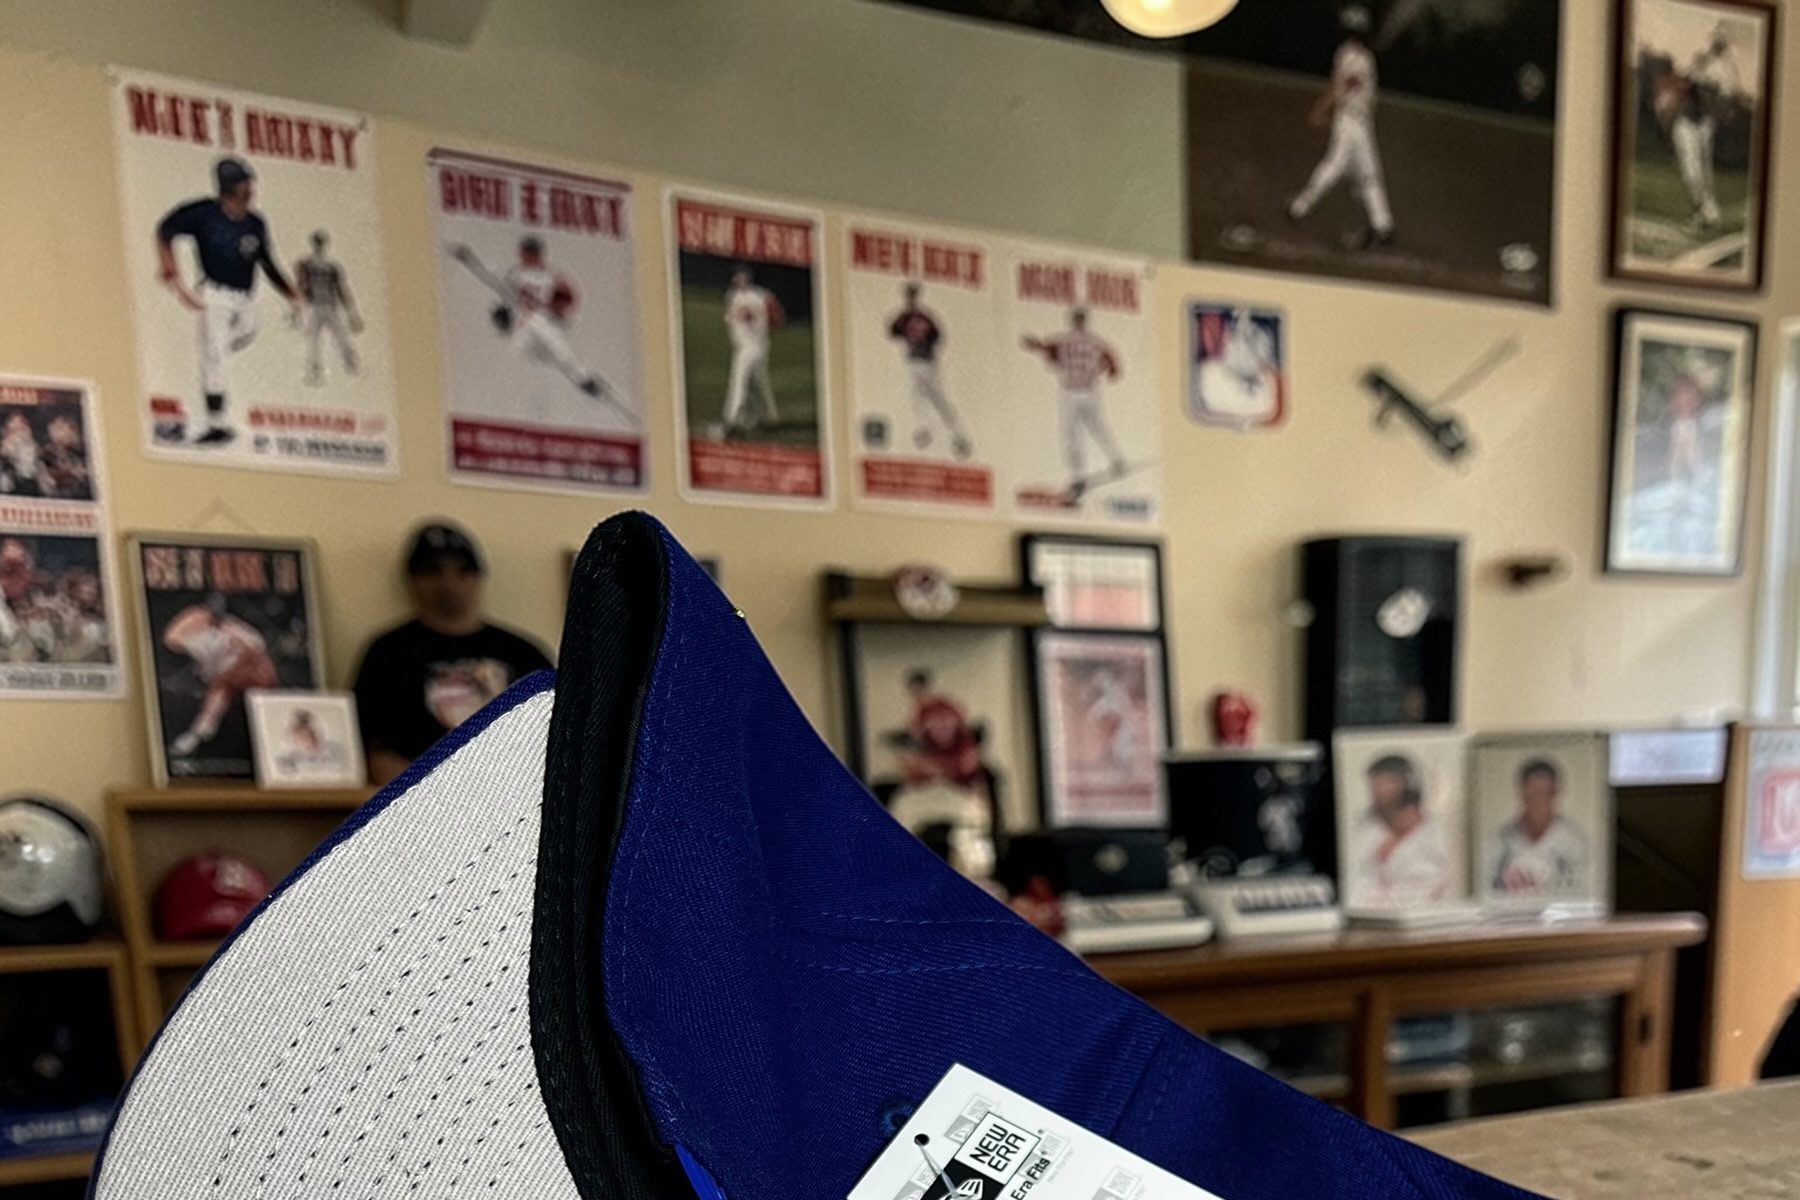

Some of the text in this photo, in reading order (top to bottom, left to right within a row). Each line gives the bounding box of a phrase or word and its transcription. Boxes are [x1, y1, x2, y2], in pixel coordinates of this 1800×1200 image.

[969, 1123, 1008, 1164] NEW
[987, 1133, 1027, 1172] ERA
[1010, 1179, 1033, 1200] Era
